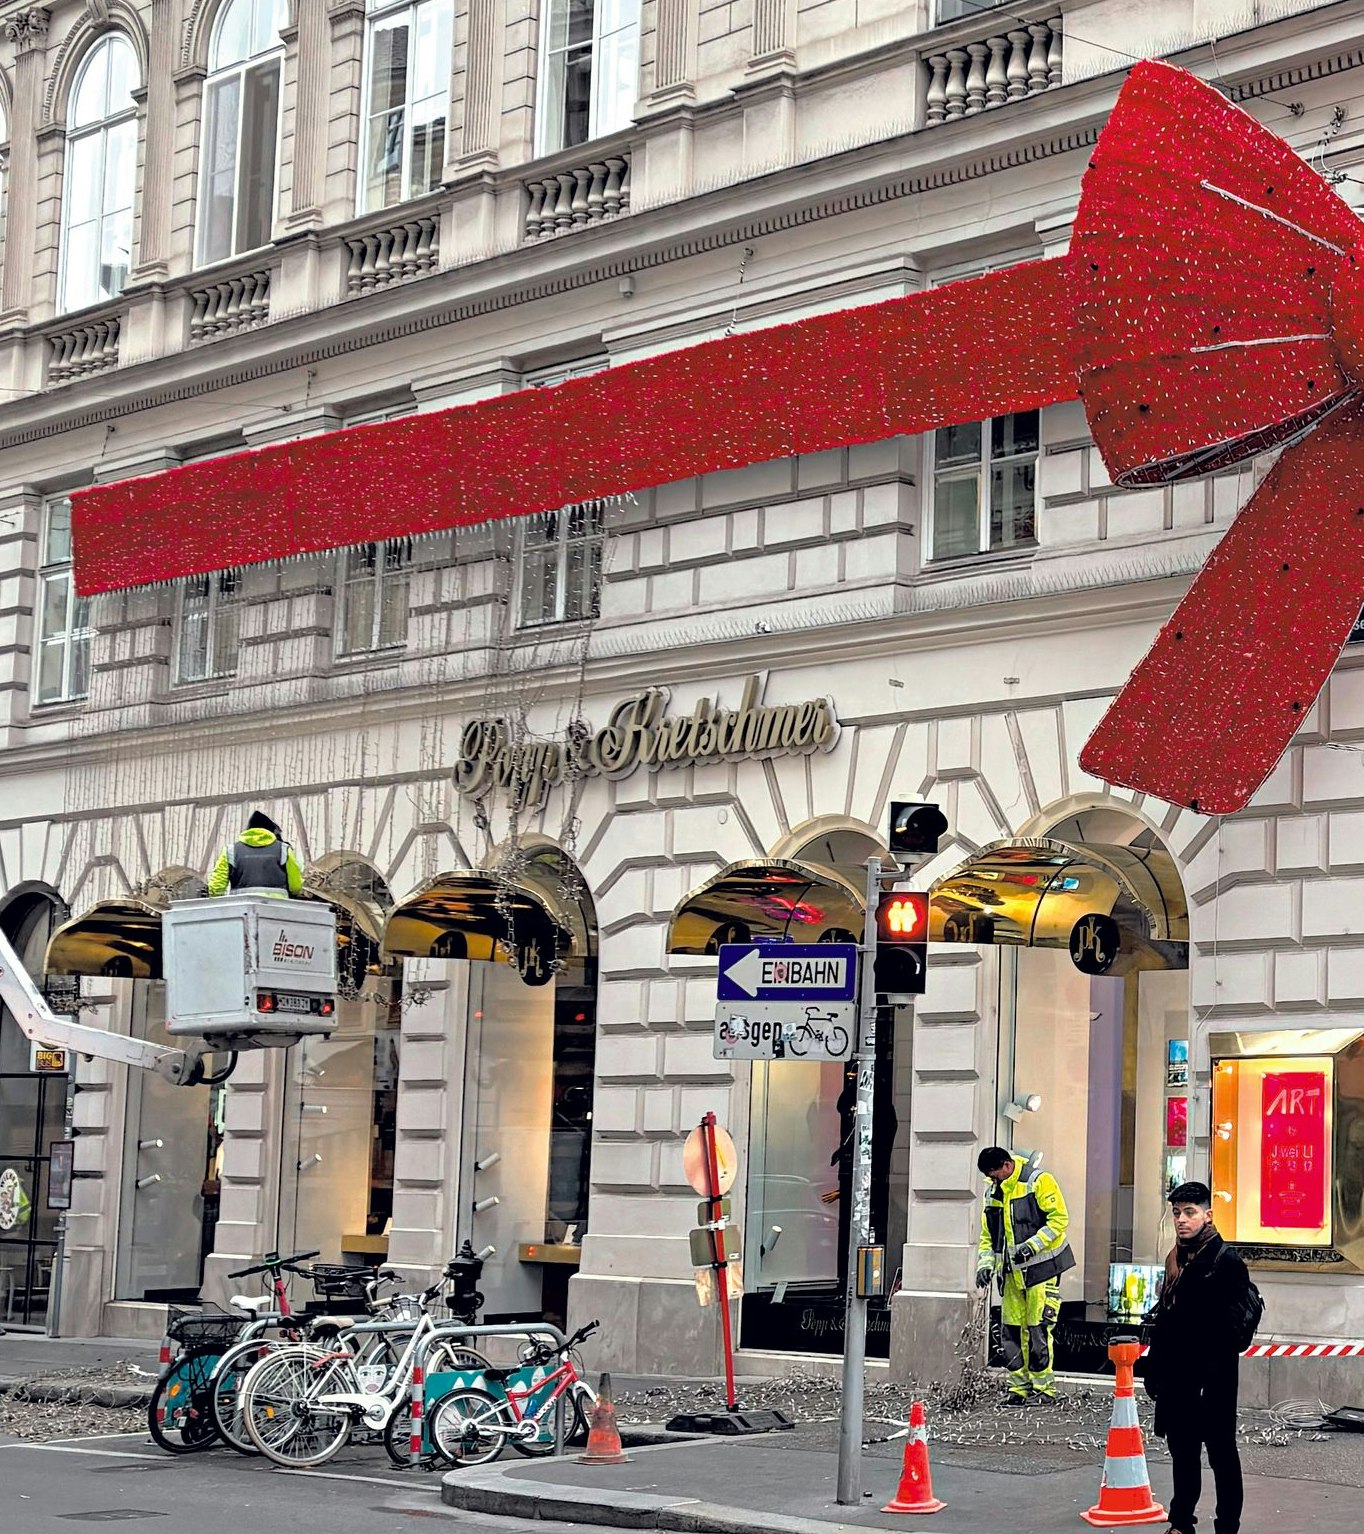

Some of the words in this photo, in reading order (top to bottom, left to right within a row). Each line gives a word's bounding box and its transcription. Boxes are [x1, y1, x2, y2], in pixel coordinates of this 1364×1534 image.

[590, 675, 834, 773] Kretschmer
[273, 942, 315, 960] BISON
[761, 961, 839, 984] EINBAHN
[720, 1021, 783, 1047] asgen
[1266, 1088, 1321, 1116] ART
